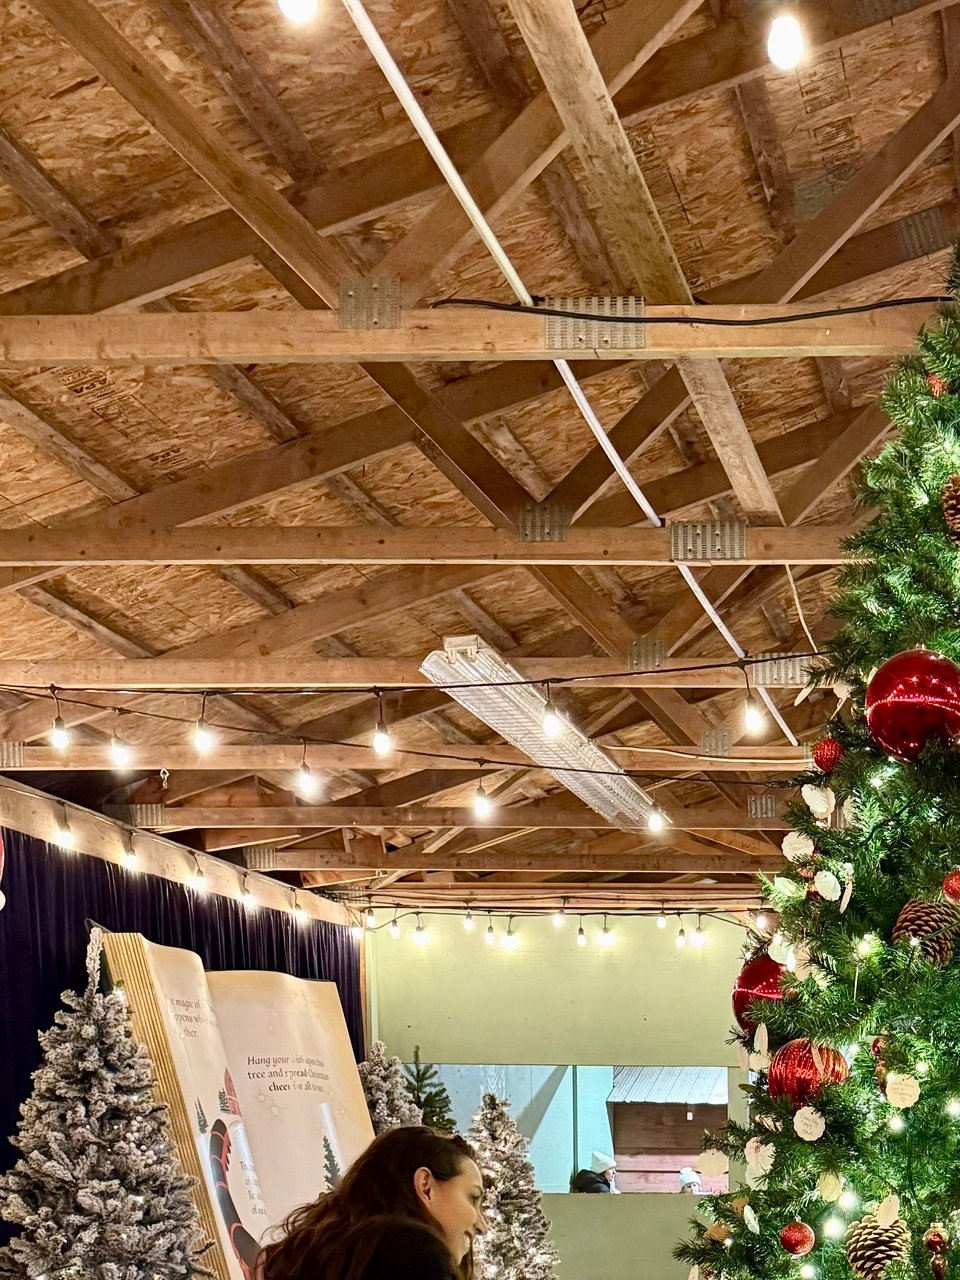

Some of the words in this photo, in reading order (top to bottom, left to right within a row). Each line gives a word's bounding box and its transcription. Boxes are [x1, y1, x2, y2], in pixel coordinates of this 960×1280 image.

[247, 1056, 271, 1067] Hang
[272, 1057, 289, 1067] your
[247, 1071, 266, 1079] tree
[268, 1068, 283, 1078] and
